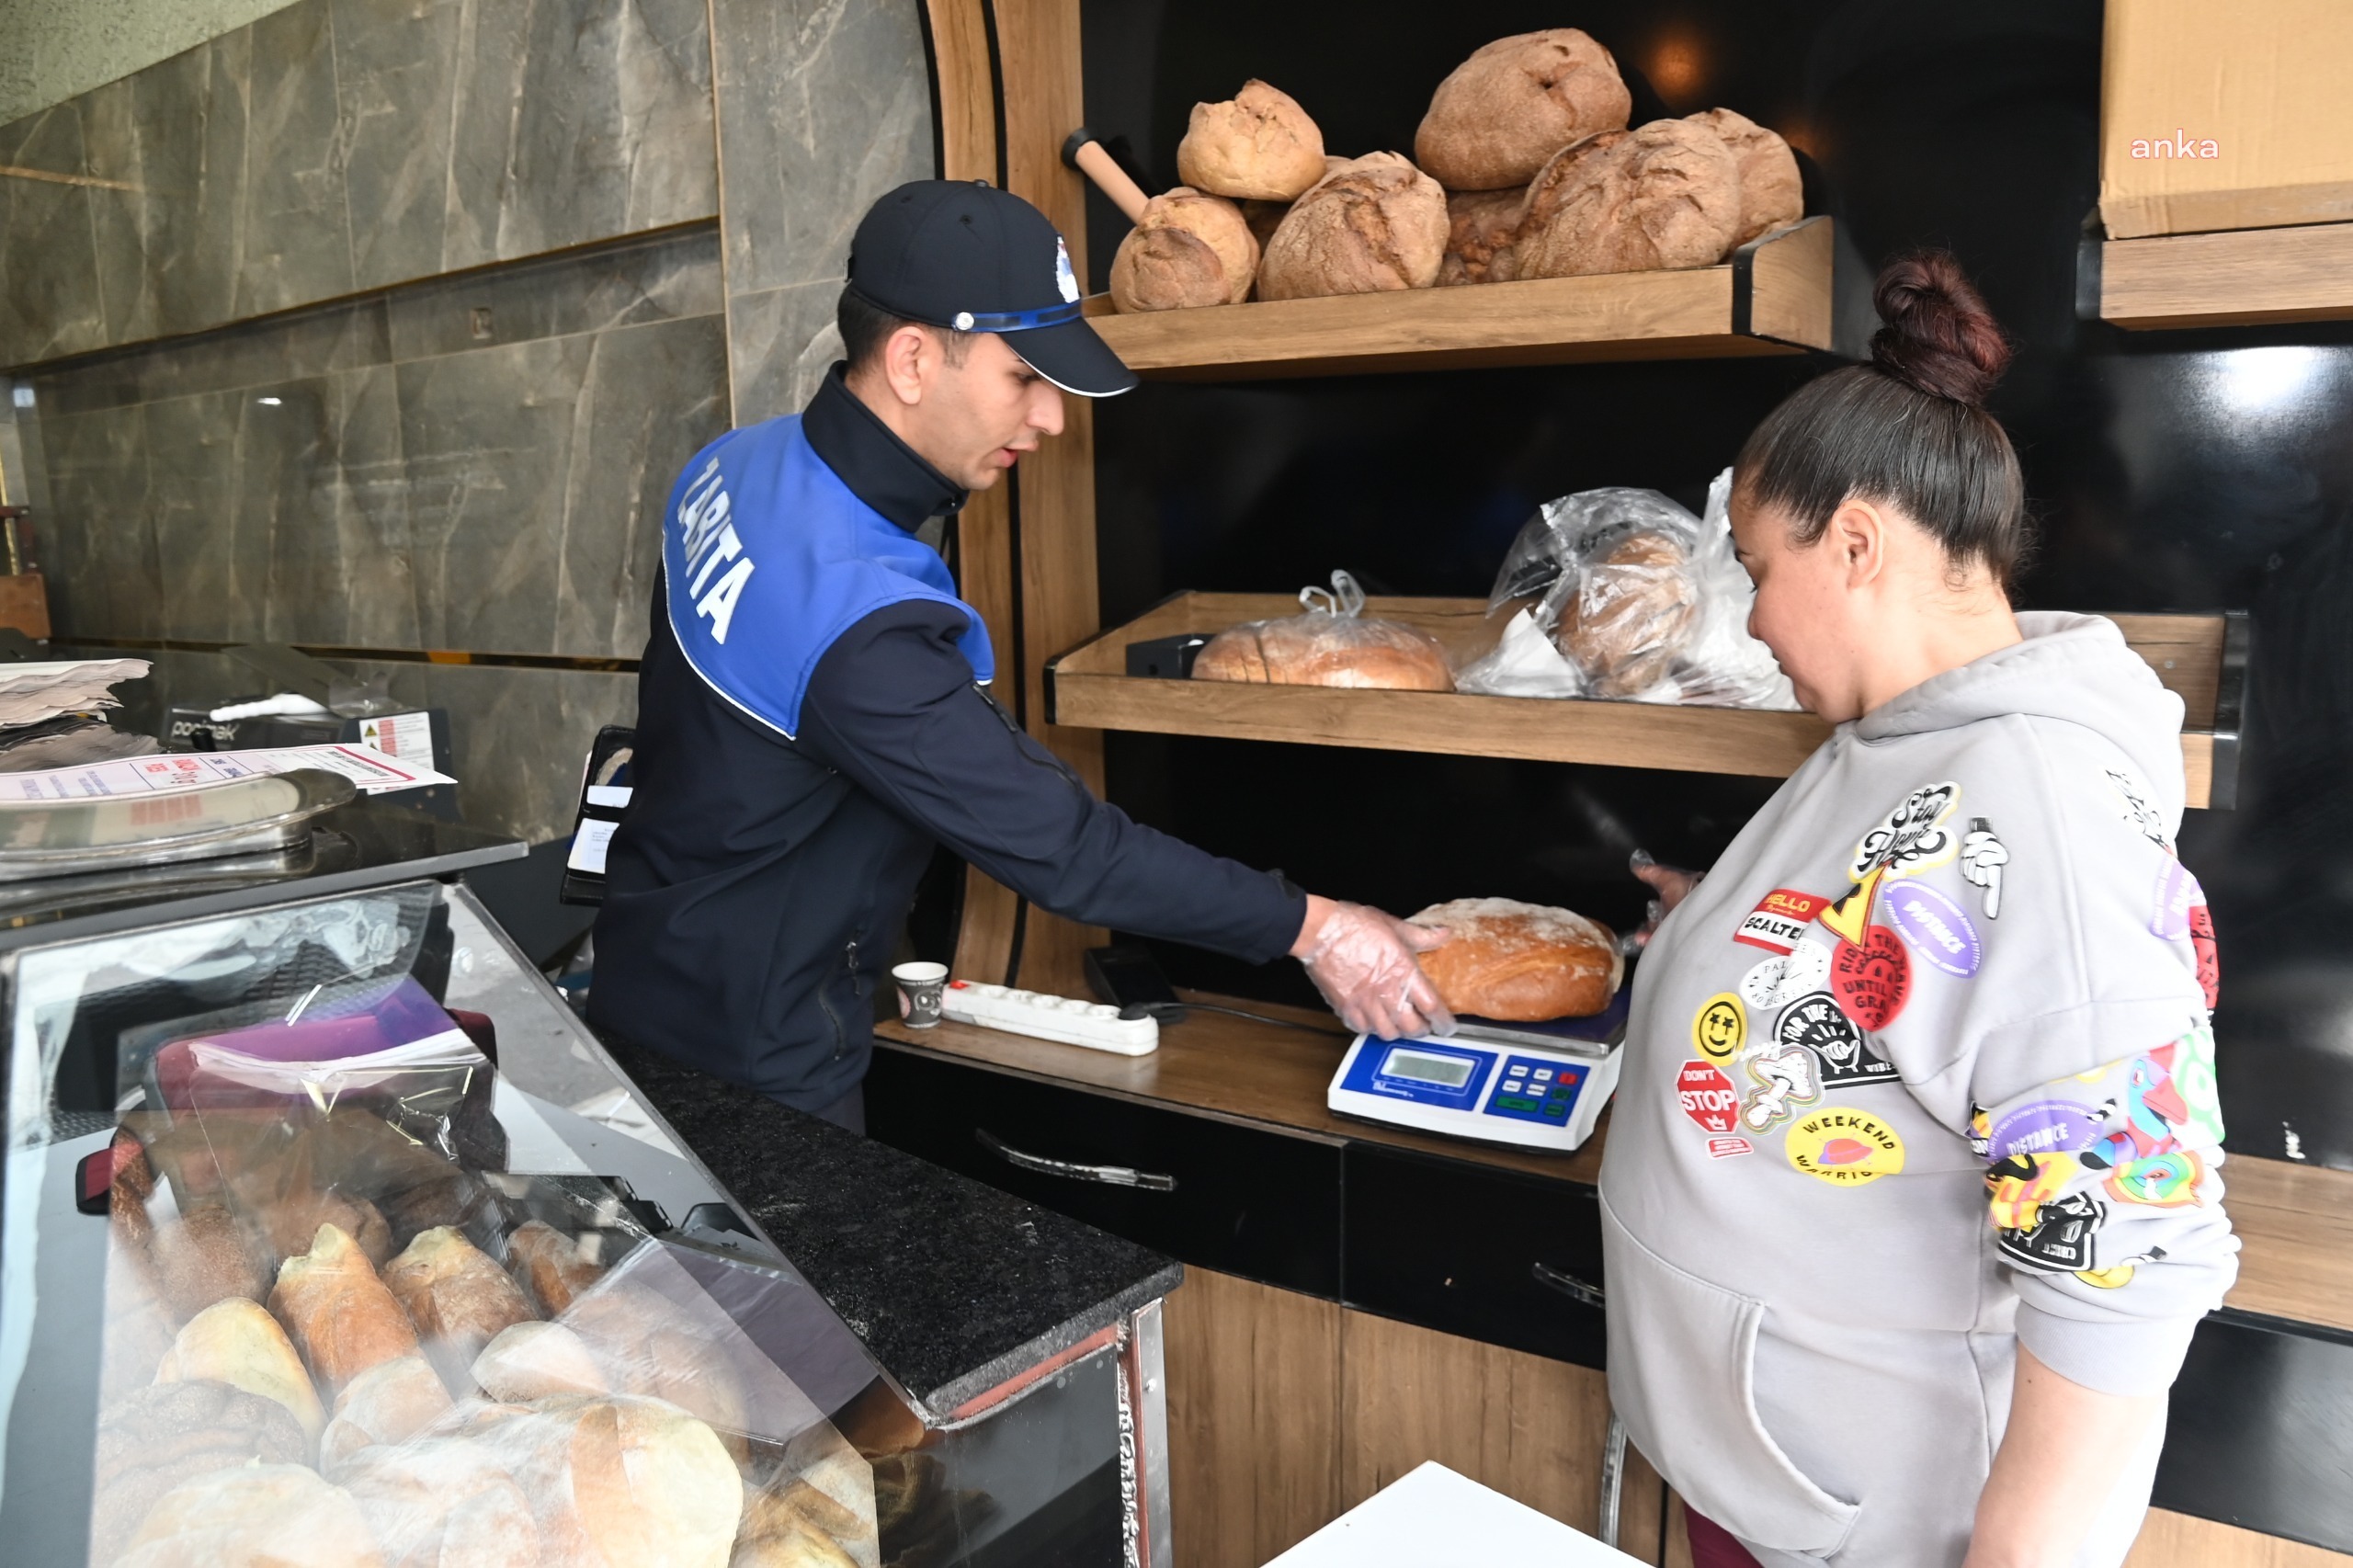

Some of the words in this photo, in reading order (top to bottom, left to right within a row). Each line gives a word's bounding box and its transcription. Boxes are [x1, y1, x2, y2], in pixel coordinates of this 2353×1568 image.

[1745, 916, 1805, 940] SCALTE
[1683, 1069, 1715, 1082] DON'T
[1680, 1089, 1735, 1112] STOP
[1802, 1116, 1895, 1150] WEEKEND
[2006, 1122, 2069, 1157] DISTANCE
[1796, 1154, 1873, 1179] WARRIO
